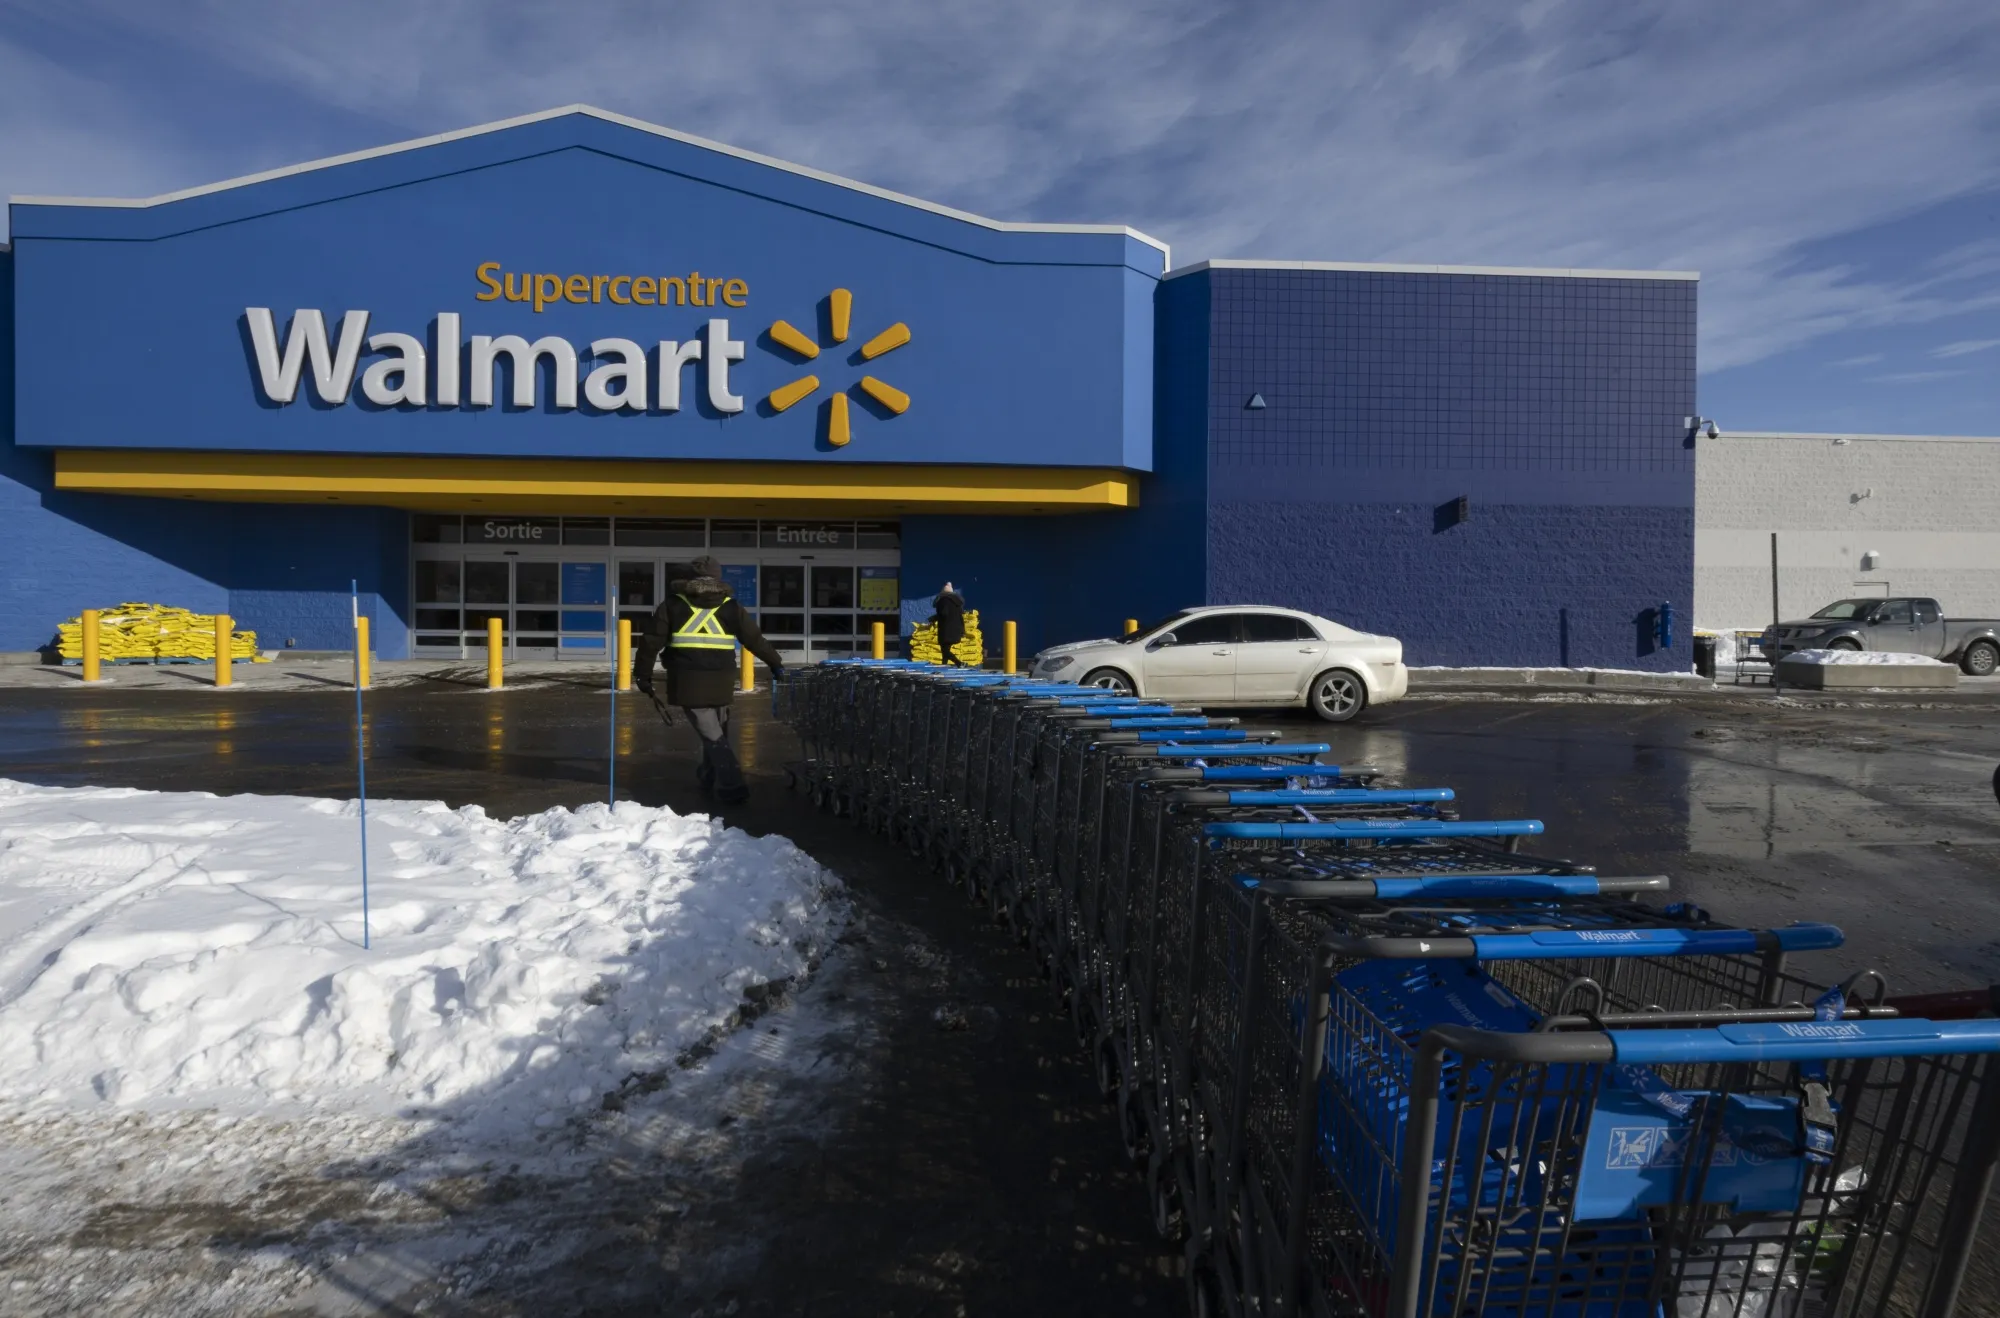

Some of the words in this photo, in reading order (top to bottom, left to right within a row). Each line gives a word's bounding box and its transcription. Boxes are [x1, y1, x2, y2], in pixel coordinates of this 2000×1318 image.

[475, 261, 749, 312] Supercentre
[245, 306, 745, 413] Walmart
[484, 521, 543, 539] Sortie
[776, 526, 839, 543] Entrée
[1365, 821, 1407, 829] Walmart
[1576, 930, 1639, 942] Walmart
[1445, 992, 1483, 1025] Walmart
[1778, 1022, 1866, 1038] Walmart
